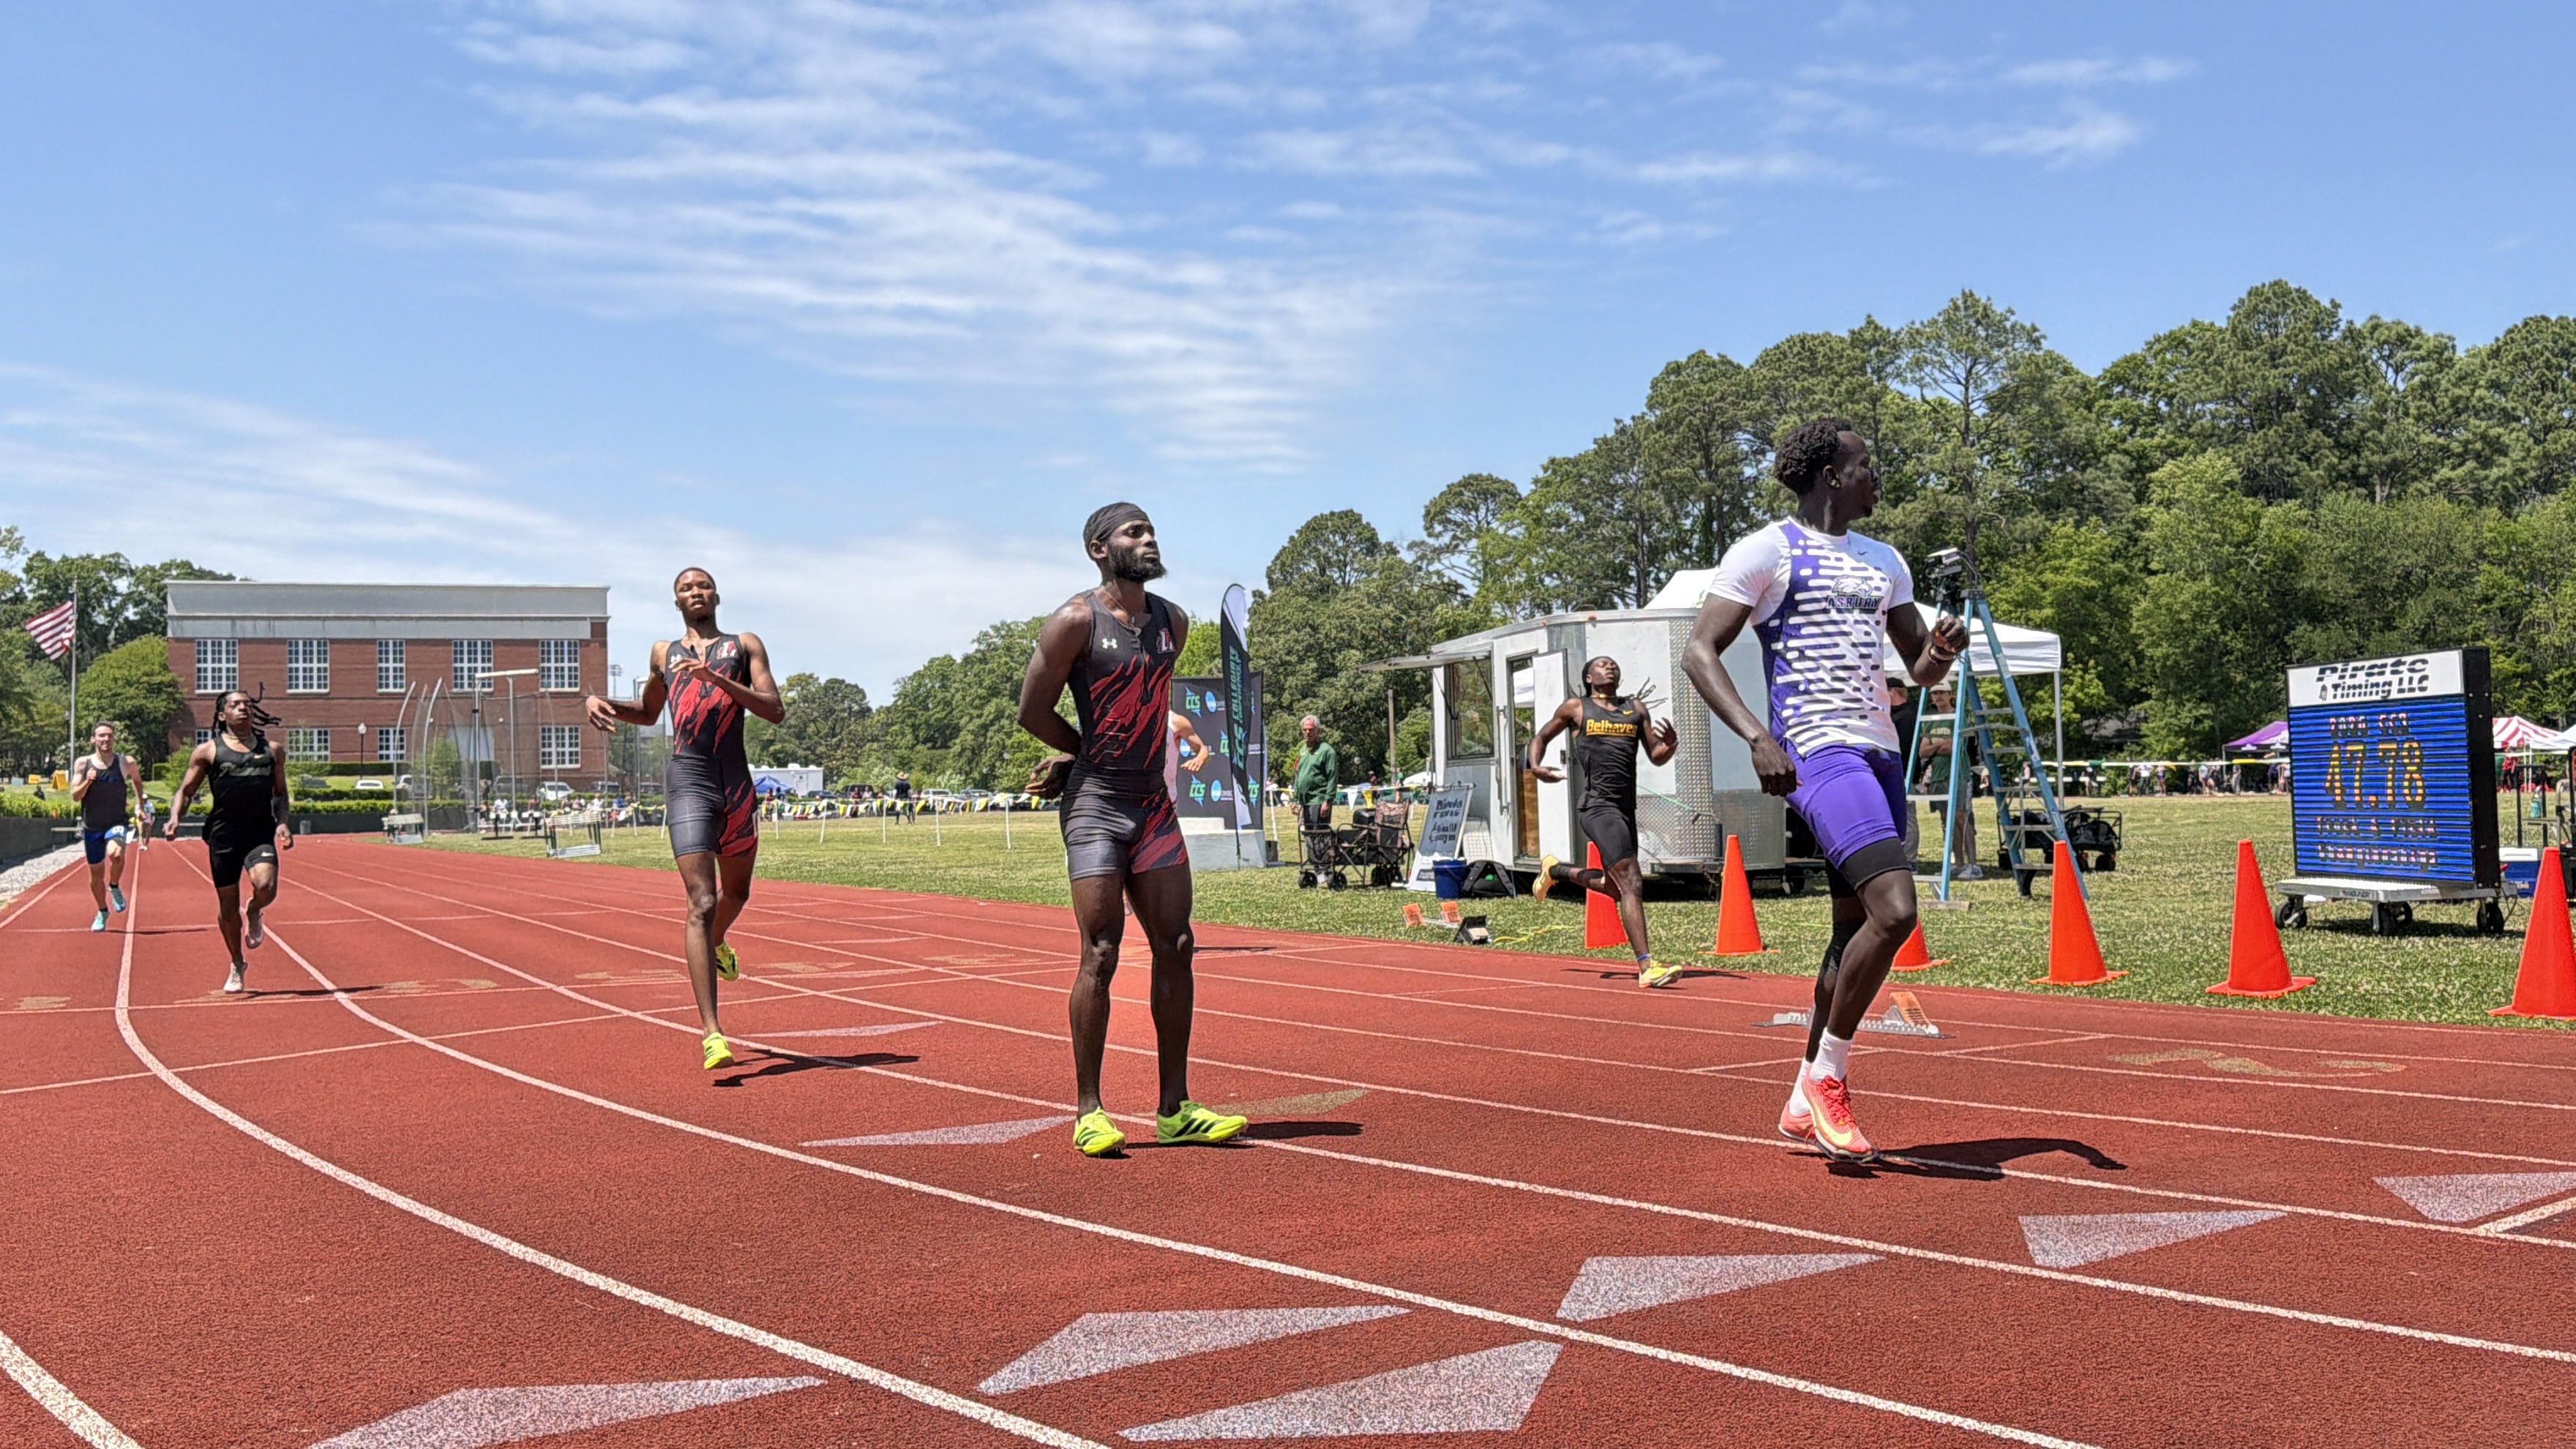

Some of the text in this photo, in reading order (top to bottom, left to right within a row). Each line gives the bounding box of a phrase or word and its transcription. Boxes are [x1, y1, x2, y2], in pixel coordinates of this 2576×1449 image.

[1827, 596, 1882, 610] ASBURY
[2315, 658, 2429, 682] Pirate
[2332, 674, 2430, 700] Timing LLC
[1186, 695, 1201, 710] CCS
[1586, 719, 1638, 733] Belhaven
[1234, 723, 1244, 771] CCS
[2324, 741, 2425, 806] 47.78
[1189, 783, 1206, 798] CCS
